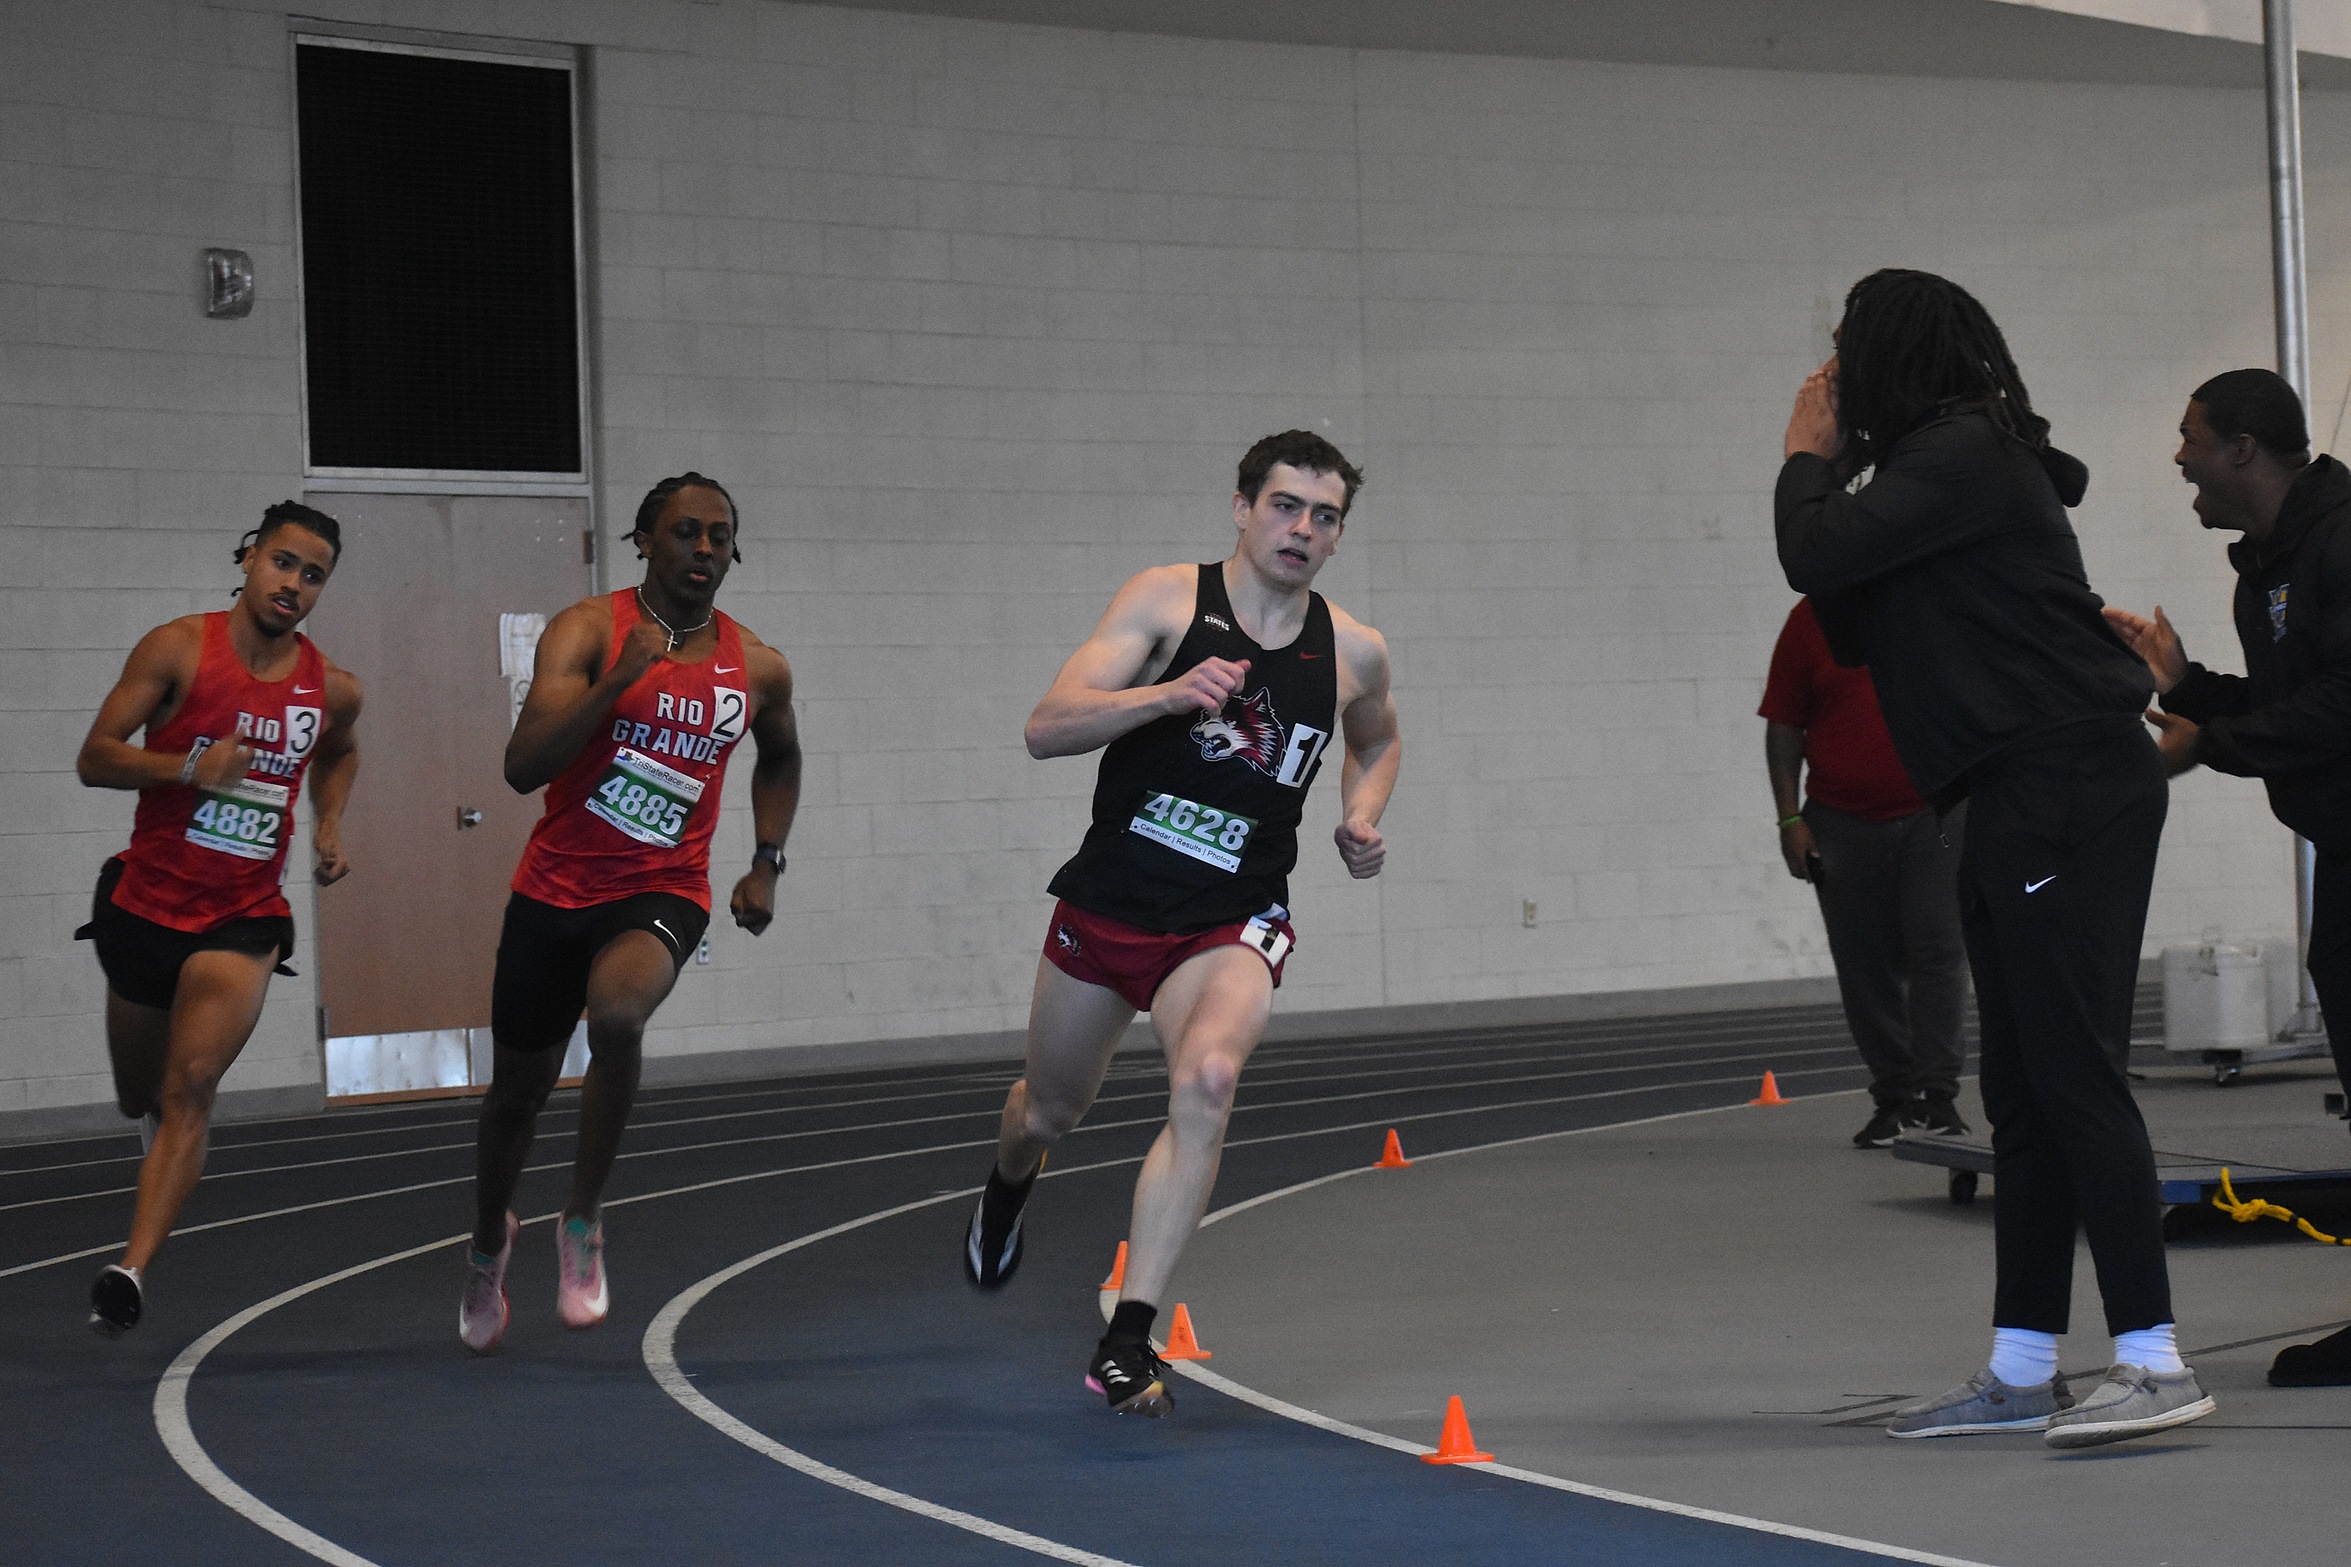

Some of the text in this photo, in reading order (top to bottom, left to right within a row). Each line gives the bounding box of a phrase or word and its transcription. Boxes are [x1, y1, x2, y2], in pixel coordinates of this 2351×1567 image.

[235, 709, 281, 744] RIO
[656, 691, 704, 726] RIO
[713, 693, 743, 738] 2
[291, 710, 316, 754] 3
[611, 718, 726, 766] GRANDE
[633, 756, 701, 794] TriStateRacer.com
[1298, 733, 1320, 783] 1
[193, 799, 281, 845] 4882
[598, 775, 689, 836] 4885
[1143, 793, 1250, 852] 4628
[622, 820, 645, 836] Results
[648, 833, 669, 848] Photos
[1140, 822, 1232, 866] Calendar Results Photos
